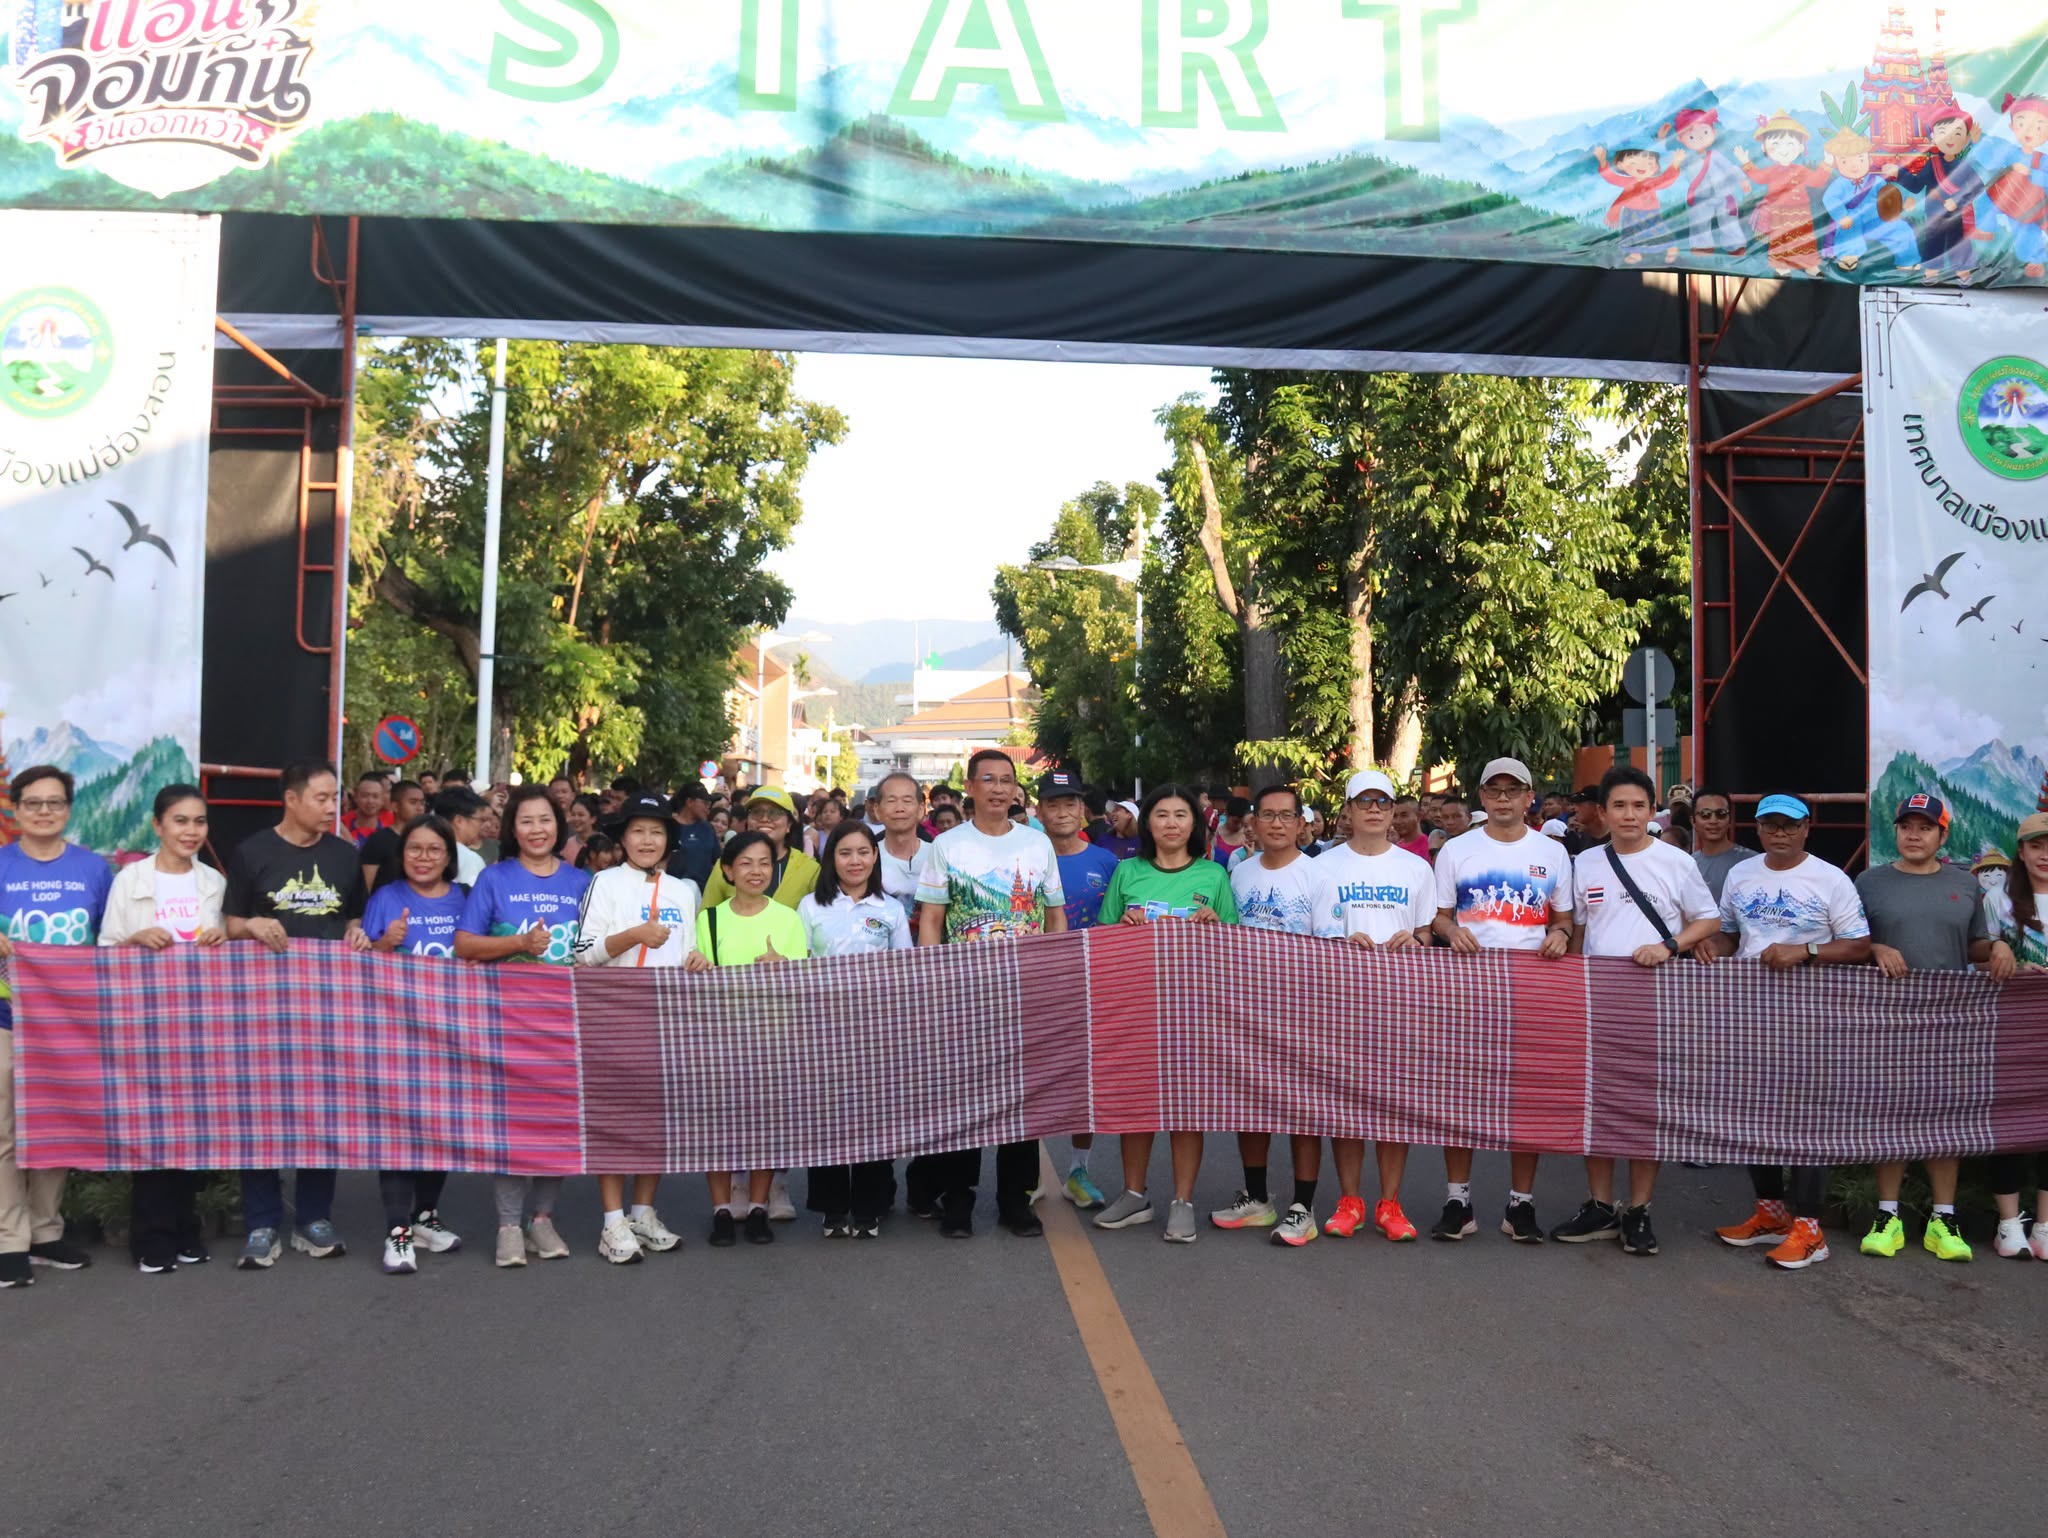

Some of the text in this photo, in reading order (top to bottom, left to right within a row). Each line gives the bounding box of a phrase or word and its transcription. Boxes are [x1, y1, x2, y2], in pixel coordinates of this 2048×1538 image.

[487, 0, 1478, 142] START
[6, 880, 86, 892] MAE HONG SON
[32, 892, 62, 902] LOOP
[509, 894, 530, 902] MAE
[532, 894, 559, 902] HONG
[534, 904, 559, 912] LOOP
[424, 915, 455, 924] HONG
[428, 925, 456, 935] LOOP
